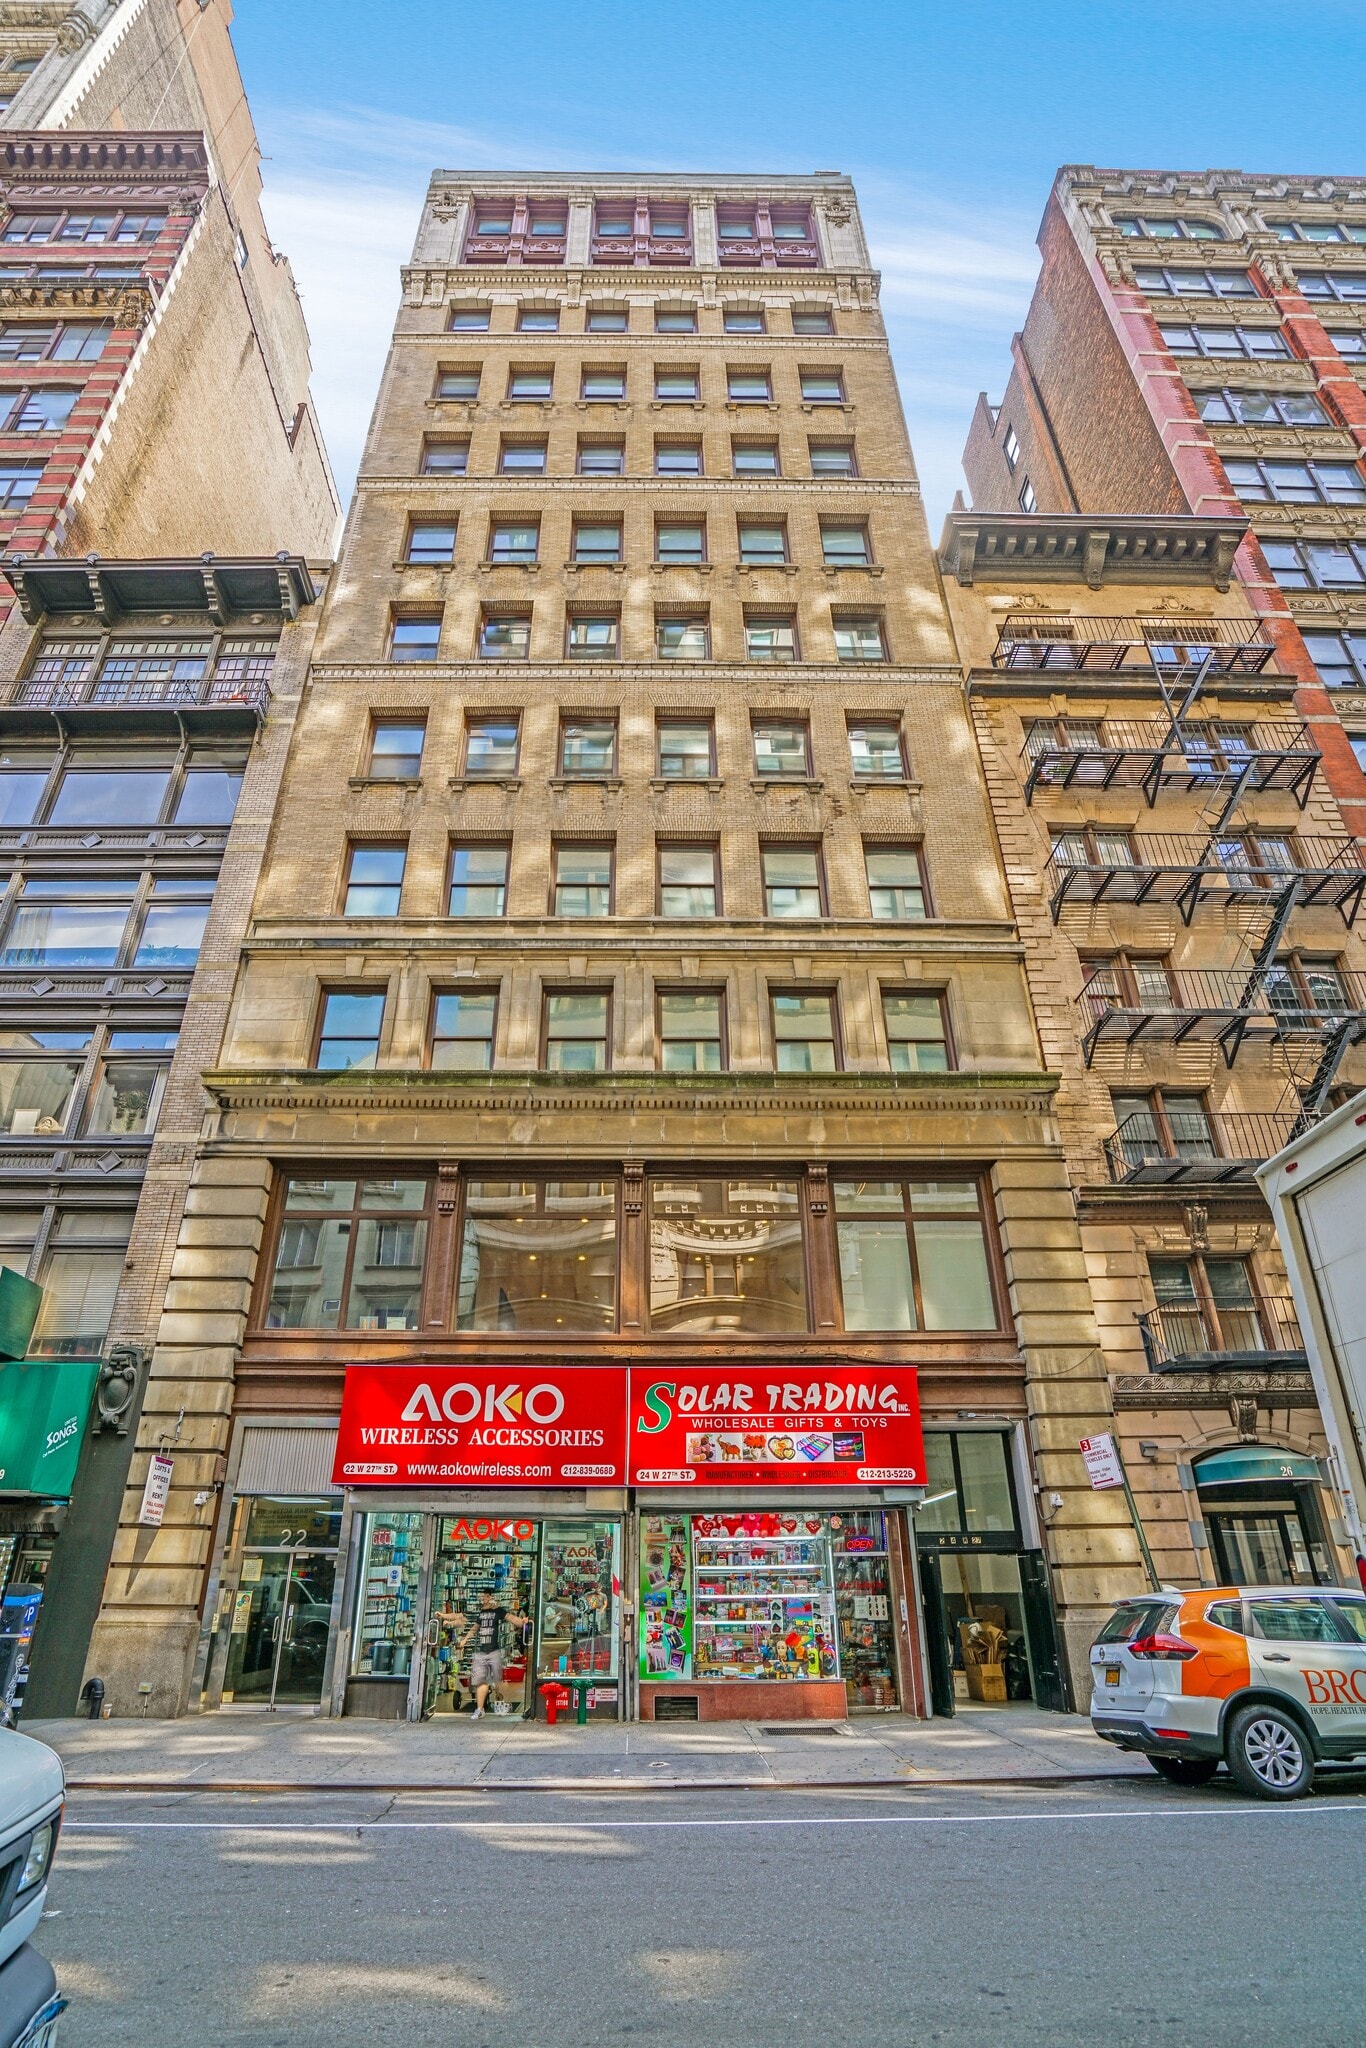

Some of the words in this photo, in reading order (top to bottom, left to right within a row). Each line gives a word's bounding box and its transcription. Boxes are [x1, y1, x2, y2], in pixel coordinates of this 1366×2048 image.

[401, 1383, 564, 1424] AOKO
[637, 1381, 754, 1433] SOLAR
[766, 1382, 899, 1413] TRADING
[898, 1403, 911, 1412] INC.
[692, 1418, 775, 1428] WHOLESALE
[784, 1418, 824, 1428] GIFTS
[834, 1418, 842, 1428] &
[852, 1418, 888, 1428] TOYS
[46, 1422, 78, 1449] SONGS
[361, 1428, 459, 1445] WIRELESS
[468, 1428, 604, 1446] ACCESSORIES
[384, 1466, 395, 1474] ST.
[407, 1462, 552, 1476] www.aokowireless.com
[640, 1472, 649, 1480] 24
[652, 1472, 660, 1480] W
[680, 1471, 692, 1480] ST.
[705, 1471, 754, 1480] MANUFACTURER
[1280, 1466, 1292, 1476] 26
[450, 1518, 534, 1541] AOKO
[280, 1529, 307, 1548] 22
[846, 1540, 873, 1550] OPEN
